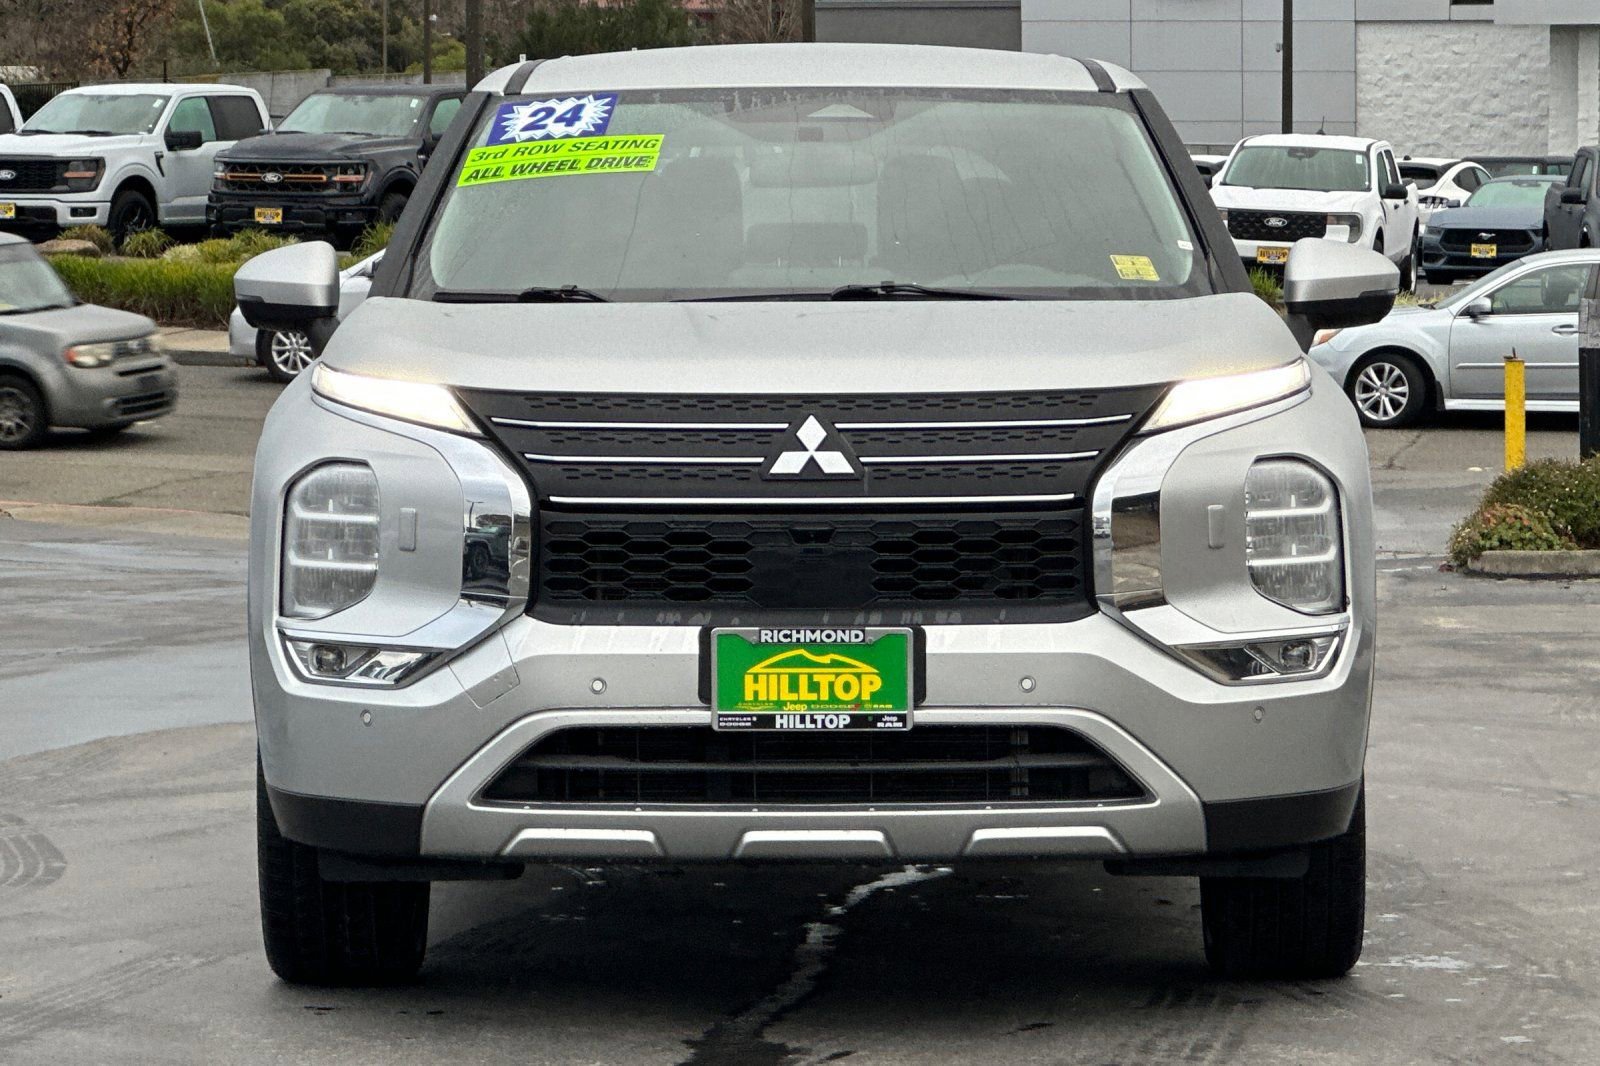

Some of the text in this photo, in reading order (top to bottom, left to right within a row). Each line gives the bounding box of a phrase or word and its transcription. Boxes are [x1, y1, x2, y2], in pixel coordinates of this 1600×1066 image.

[520, 105, 582, 131] 24
[472, 139, 659, 162] 3rd ROW SEATING
[464, 155, 653, 183] ALL WHEEL DRIVE
[760, 630, 864, 643] RICHMOND
[744, 674, 882, 701] HILLTOP
[783, 702, 808, 712] Jeep
[775, 715, 851, 729] HILLTOP
